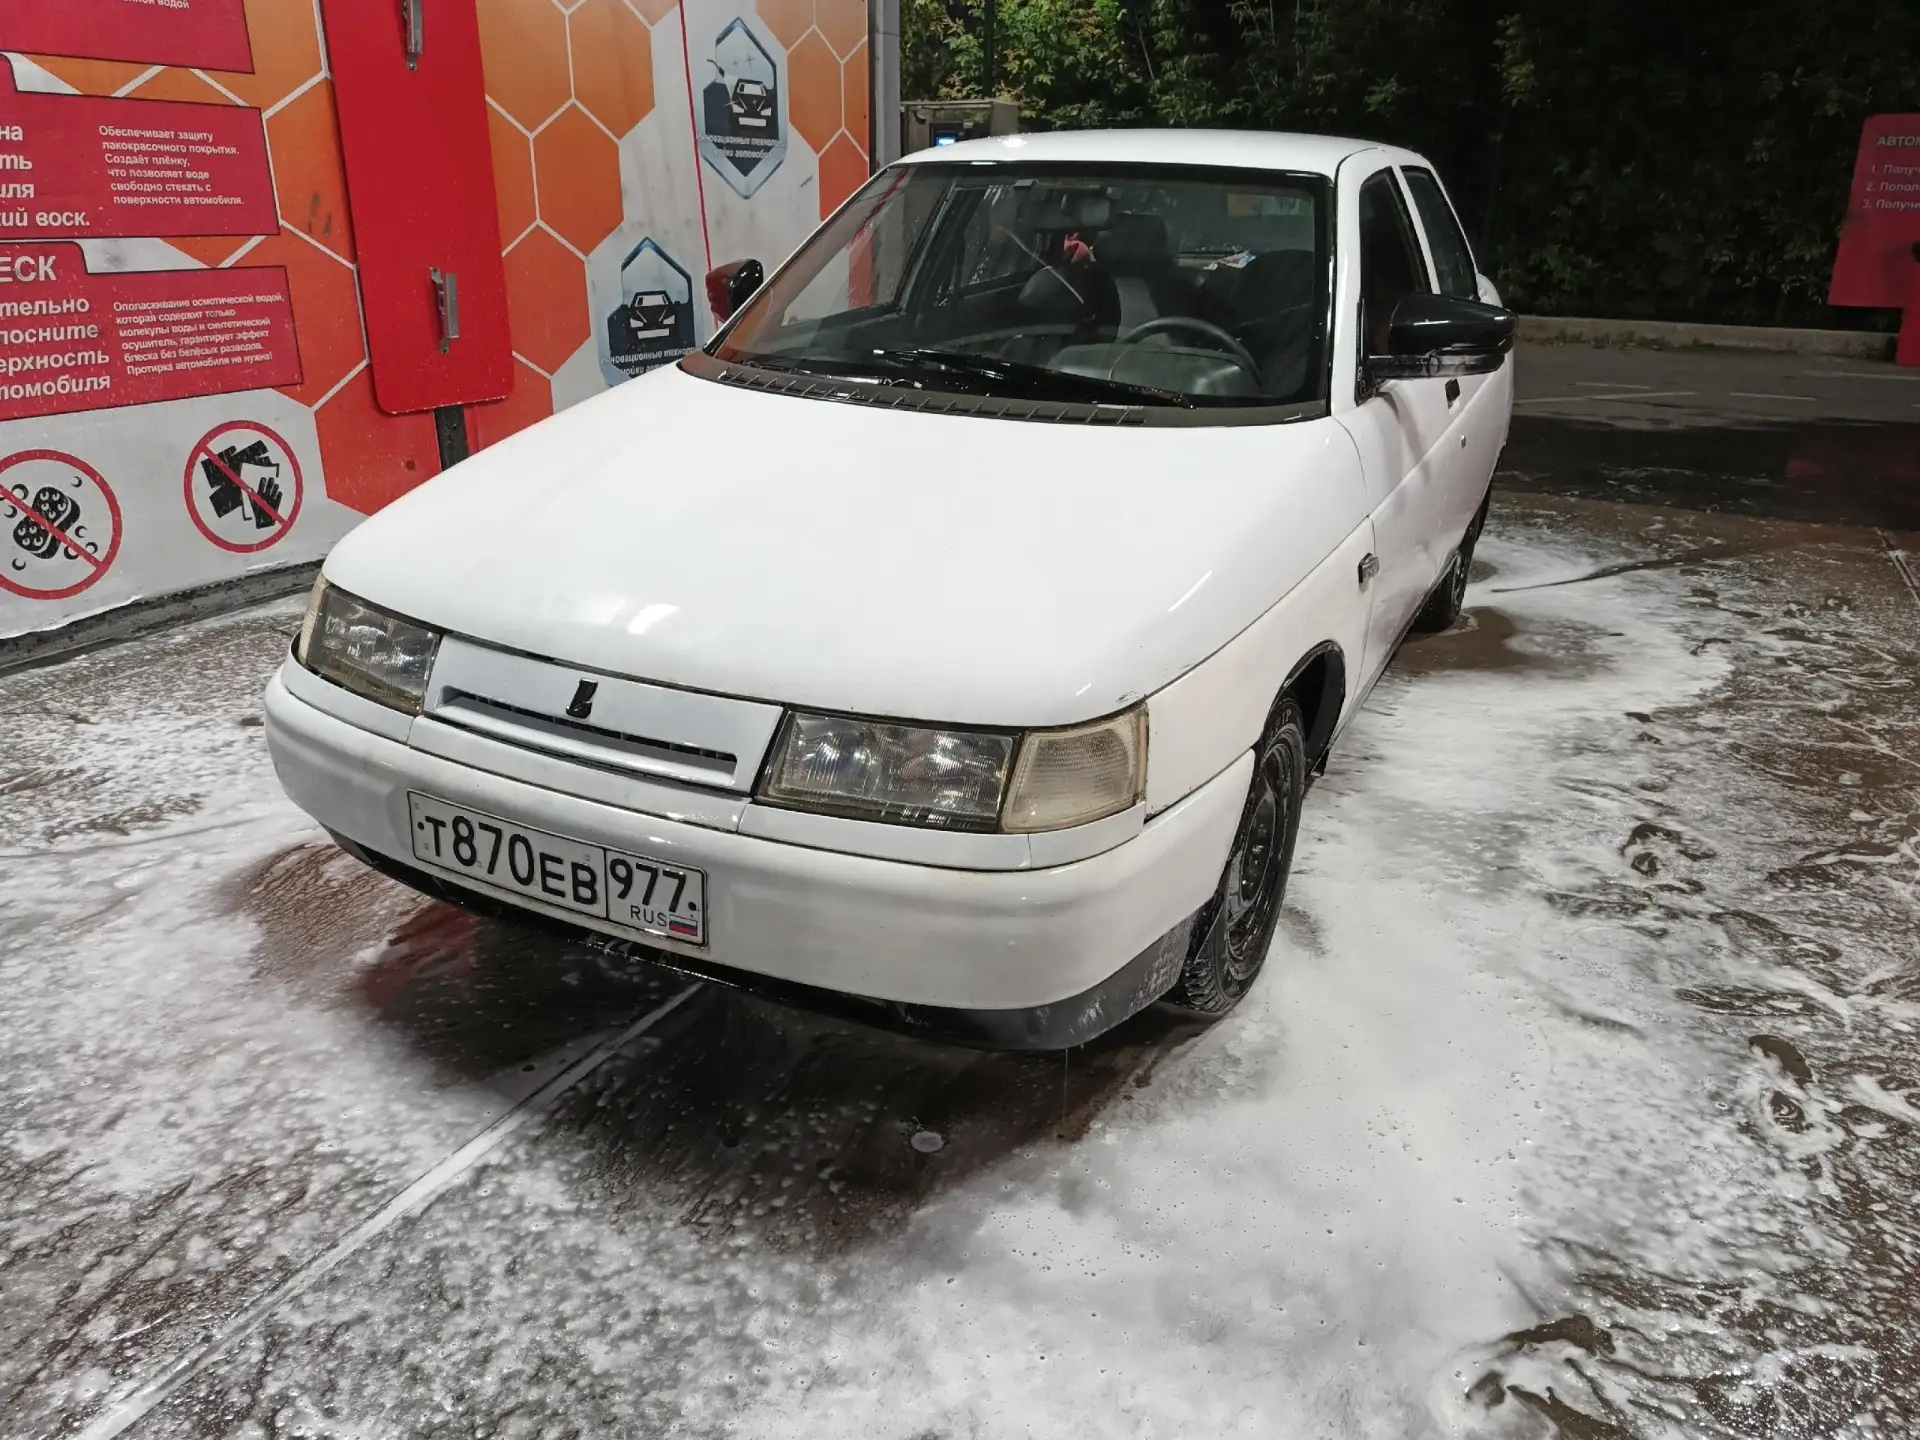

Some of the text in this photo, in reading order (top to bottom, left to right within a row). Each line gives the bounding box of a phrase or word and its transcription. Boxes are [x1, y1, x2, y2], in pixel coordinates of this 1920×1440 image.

[98, 125, 214, 143] Обеспечивает защиту
[104, 153, 149, 165] Создаёт
[189, 145, 240, 156] покрытия.
[107, 168, 210, 180] что позволяет воде
[110, 181, 212, 192] свободно стекать с
[113, 194, 245, 207] поверхности автомобиля.
[35, 211, 91, 227] воск.
[192, 294, 254, 307] осмотической
[116, 308, 236, 325] которая содержит только
[119, 317, 271, 338] молекулы воды и синтетический
[121, 329, 269, 351] осушитель, гарантирует эффект
[124, 351, 159, 363] блеска
[160, 348, 177, 360] без
[220, 342, 264, 355] разводов.
[126, 350, 273, 377] Протирка автомобиля не нужна!
[425, 815, 687, 913] Т870ЕВ 977
[630, 904, 668, 927] RUS
